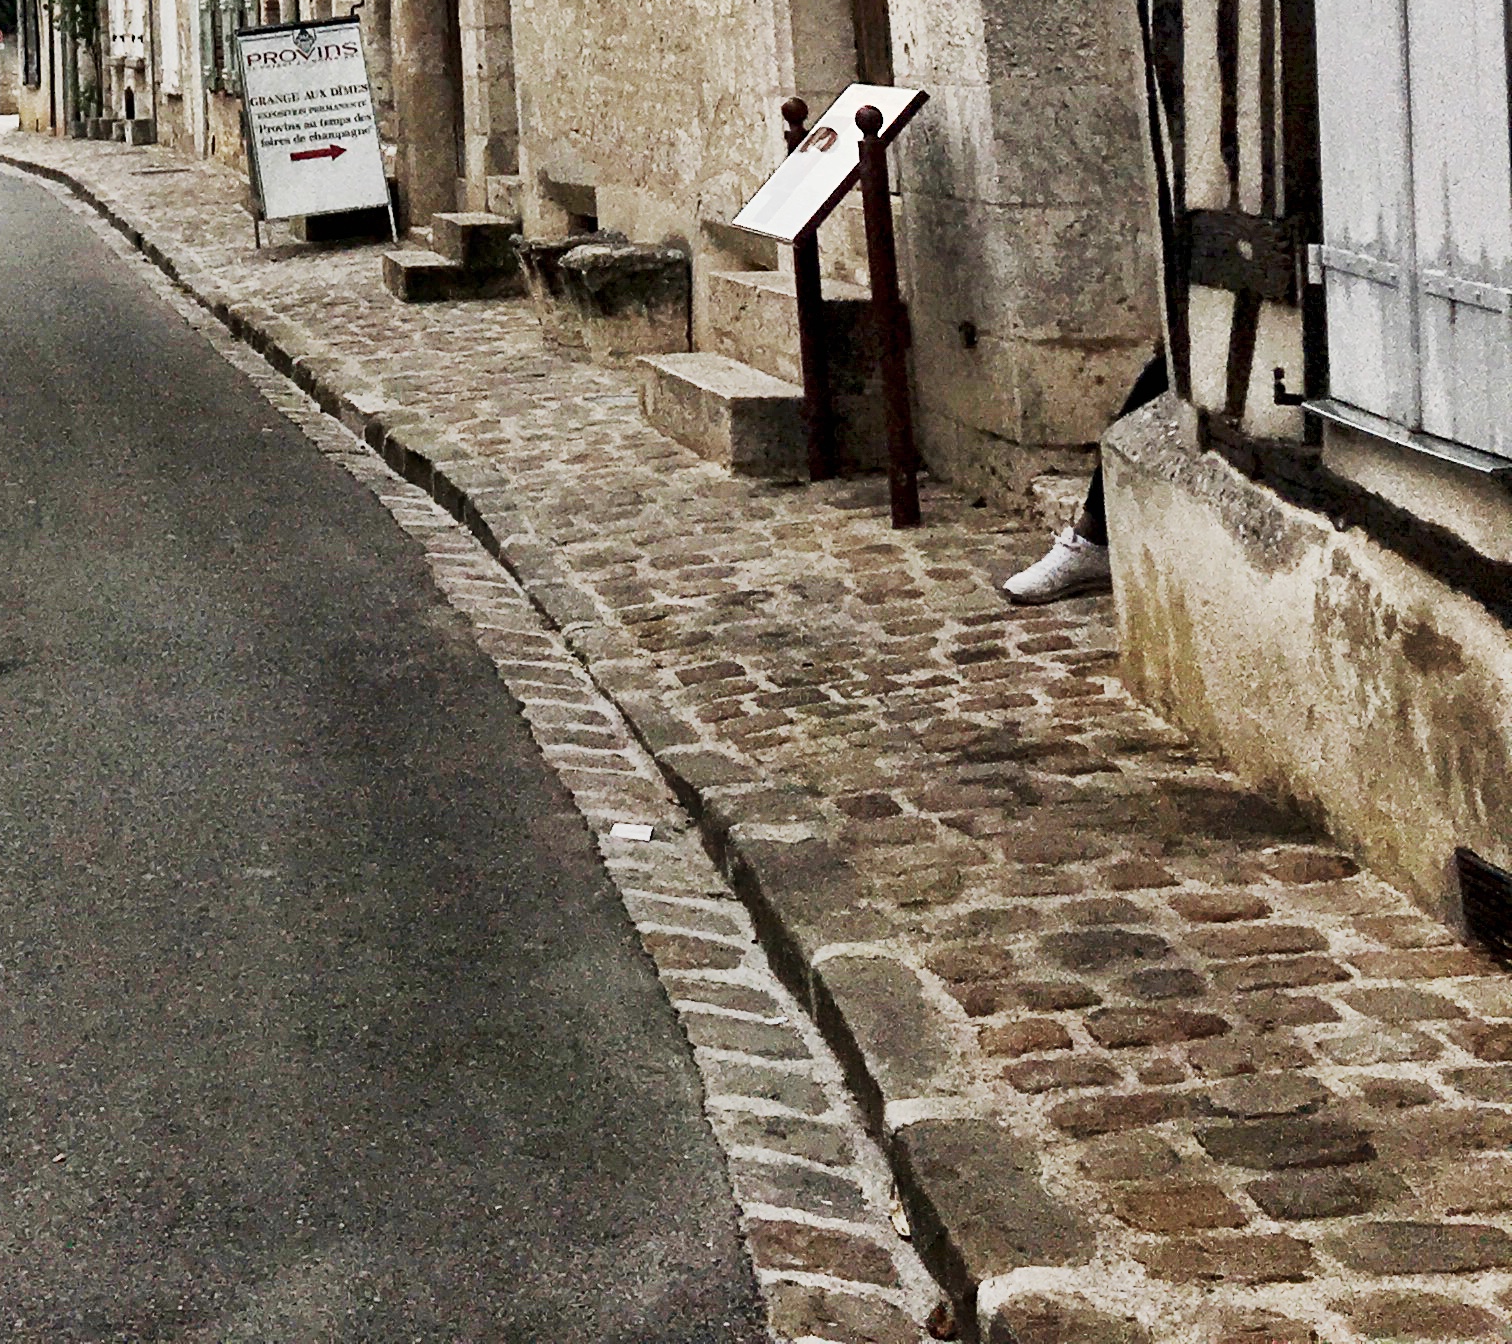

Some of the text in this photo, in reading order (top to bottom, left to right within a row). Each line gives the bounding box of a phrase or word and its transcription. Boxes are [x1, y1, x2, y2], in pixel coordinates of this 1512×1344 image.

[247, 41, 358, 67] PROVINS
[250, 92, 300, 107] GRANGE
[304, 89, 327, 101] AUX
[257, 100, 367, 120] EXPOSITION PERMANENTE
[304, 120, 317, 129] au
[320, 117, 351, 128] temps
[354, 113, 372, 123] des
[261, 137, 291, 148] foires
[293, 133, 306, 143] de
